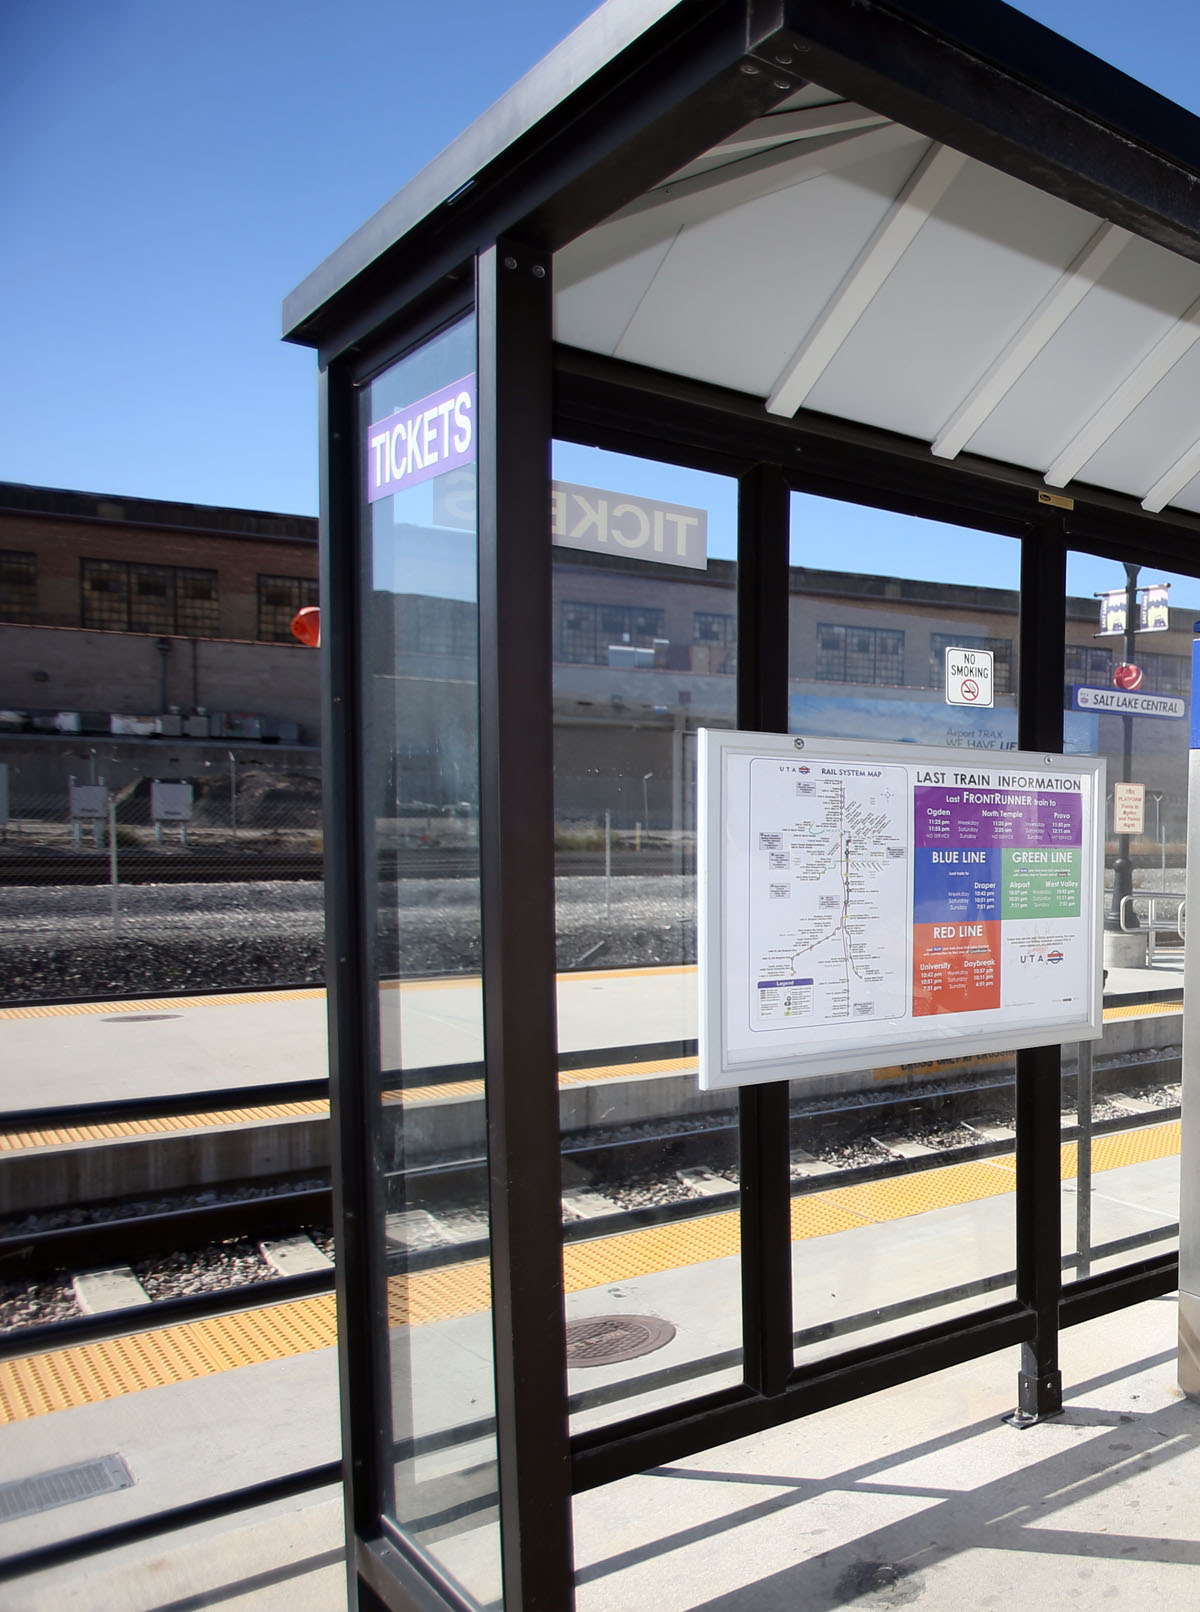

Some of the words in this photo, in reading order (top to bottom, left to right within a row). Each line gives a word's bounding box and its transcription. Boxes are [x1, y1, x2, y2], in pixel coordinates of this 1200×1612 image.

[371, 391, 472, 487] TICKETS
[964, 653, 976, 664] NO
[951, 664, 989, 678] SMOKING
[1093, 694, 1115, 706] SALT
[1116, 696, 1138, 710] LAKE
[1140, 699, 1178, 713] CENTRAL
[947, 728, 975, 739] Airport
[1000, 742, 1018, 750] LIF
[822, 768, 837, 776] RAIL
[839, 769, 865, 777] SYSTEM
[916, 771, 946, 784] LAST
[954, 774, 990, 786] TRAIN
[998, 776, 1081, 790] INFORMATION
[946, 795, 960, 803] Last
[927, 808, 950, 816] Ogden
[932, 851, 958, 863] BLUE
[963, 852, 986, 863] LINE
[1012, 852, 1047, 863] GREEN
[1051, 852, 1073, 863] LINE
[934, 926, 956, 938] RED
[959, 925, 983, 937] LINE
[964, 960, 995, 968] Daybreak
[1020, 955, 1044, 964] UTA
